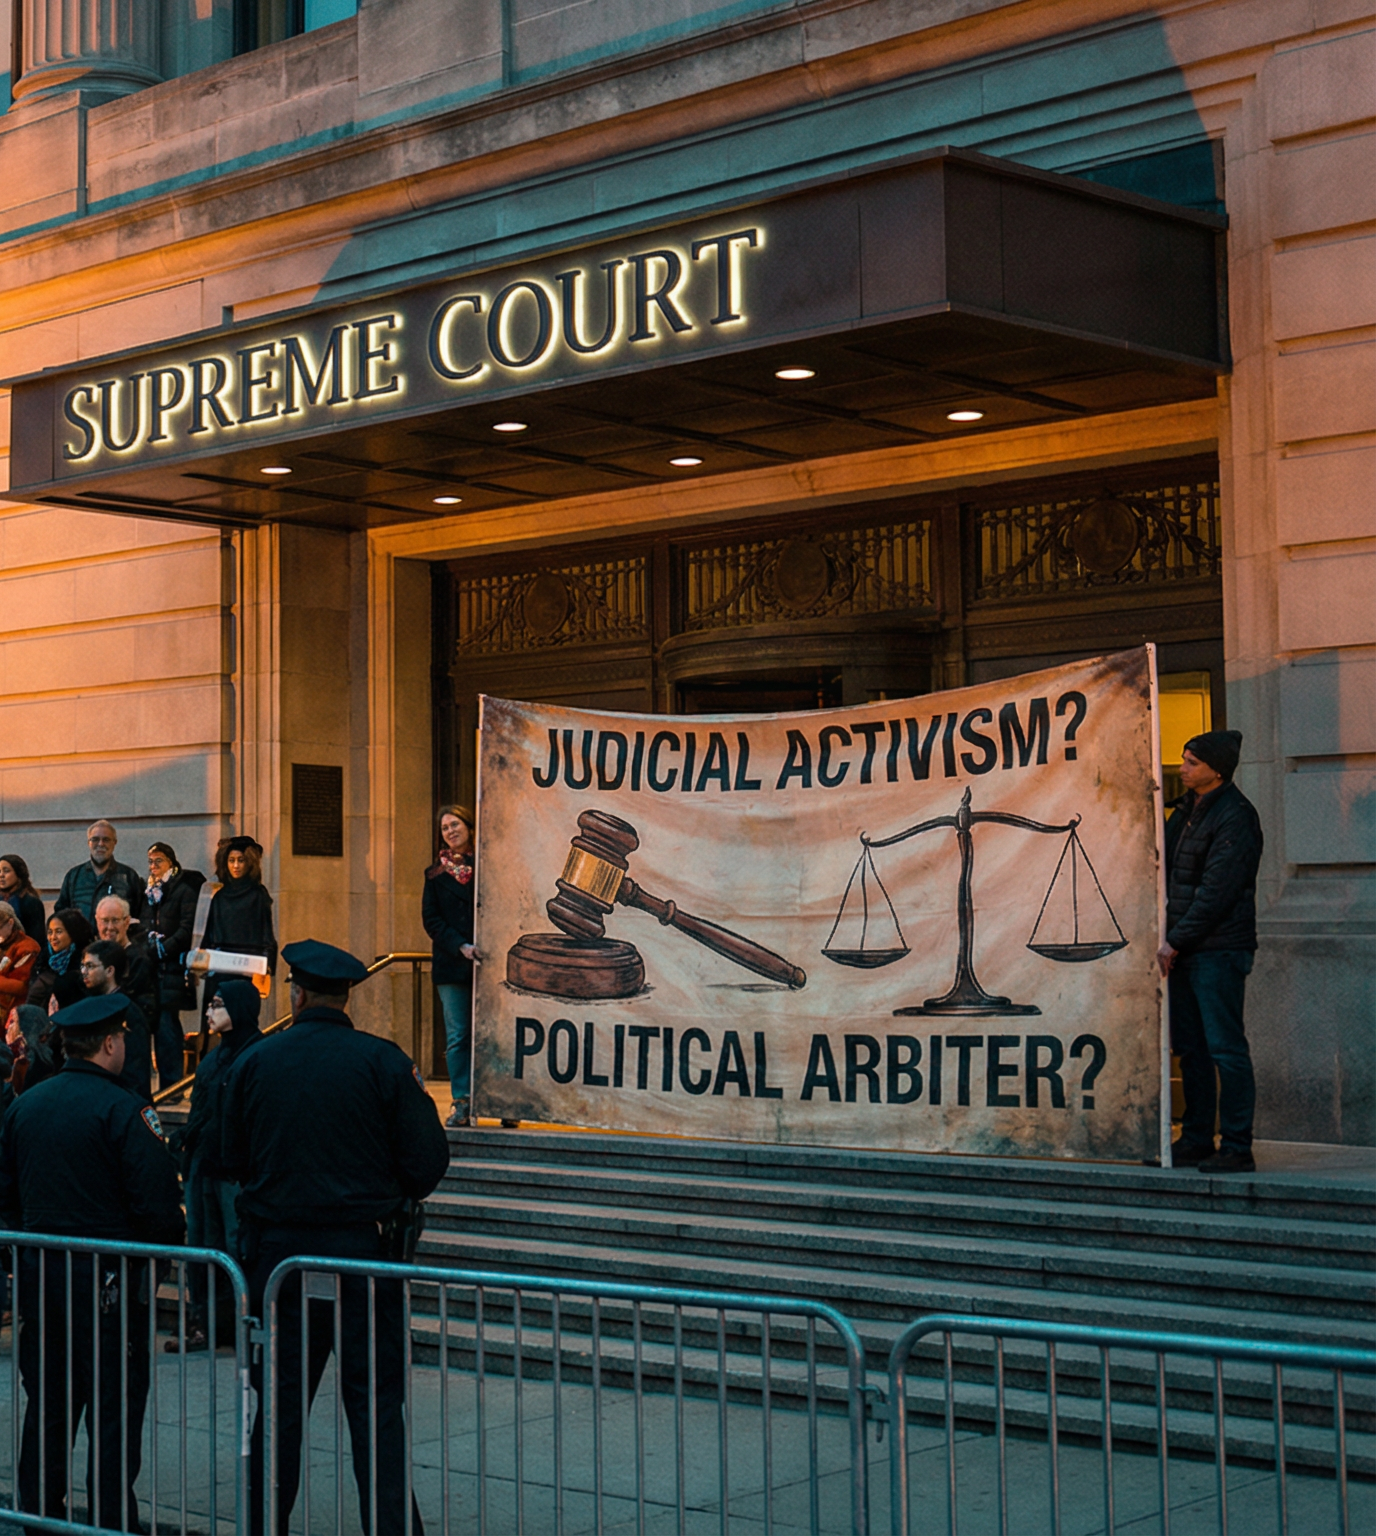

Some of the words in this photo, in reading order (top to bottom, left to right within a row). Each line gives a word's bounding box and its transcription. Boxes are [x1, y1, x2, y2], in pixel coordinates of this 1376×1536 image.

[63, 313, 402, 462] SUPREME
[428, 226, 760, 382] COURT
[532, 727, 762, 793] JUDICIAL
[775, 690, 1089, 790] ACTIVISM?
[514, 1017, 784, 1100] POLITICAL
[800, 1033, 1108, 1111] ARBITER?
